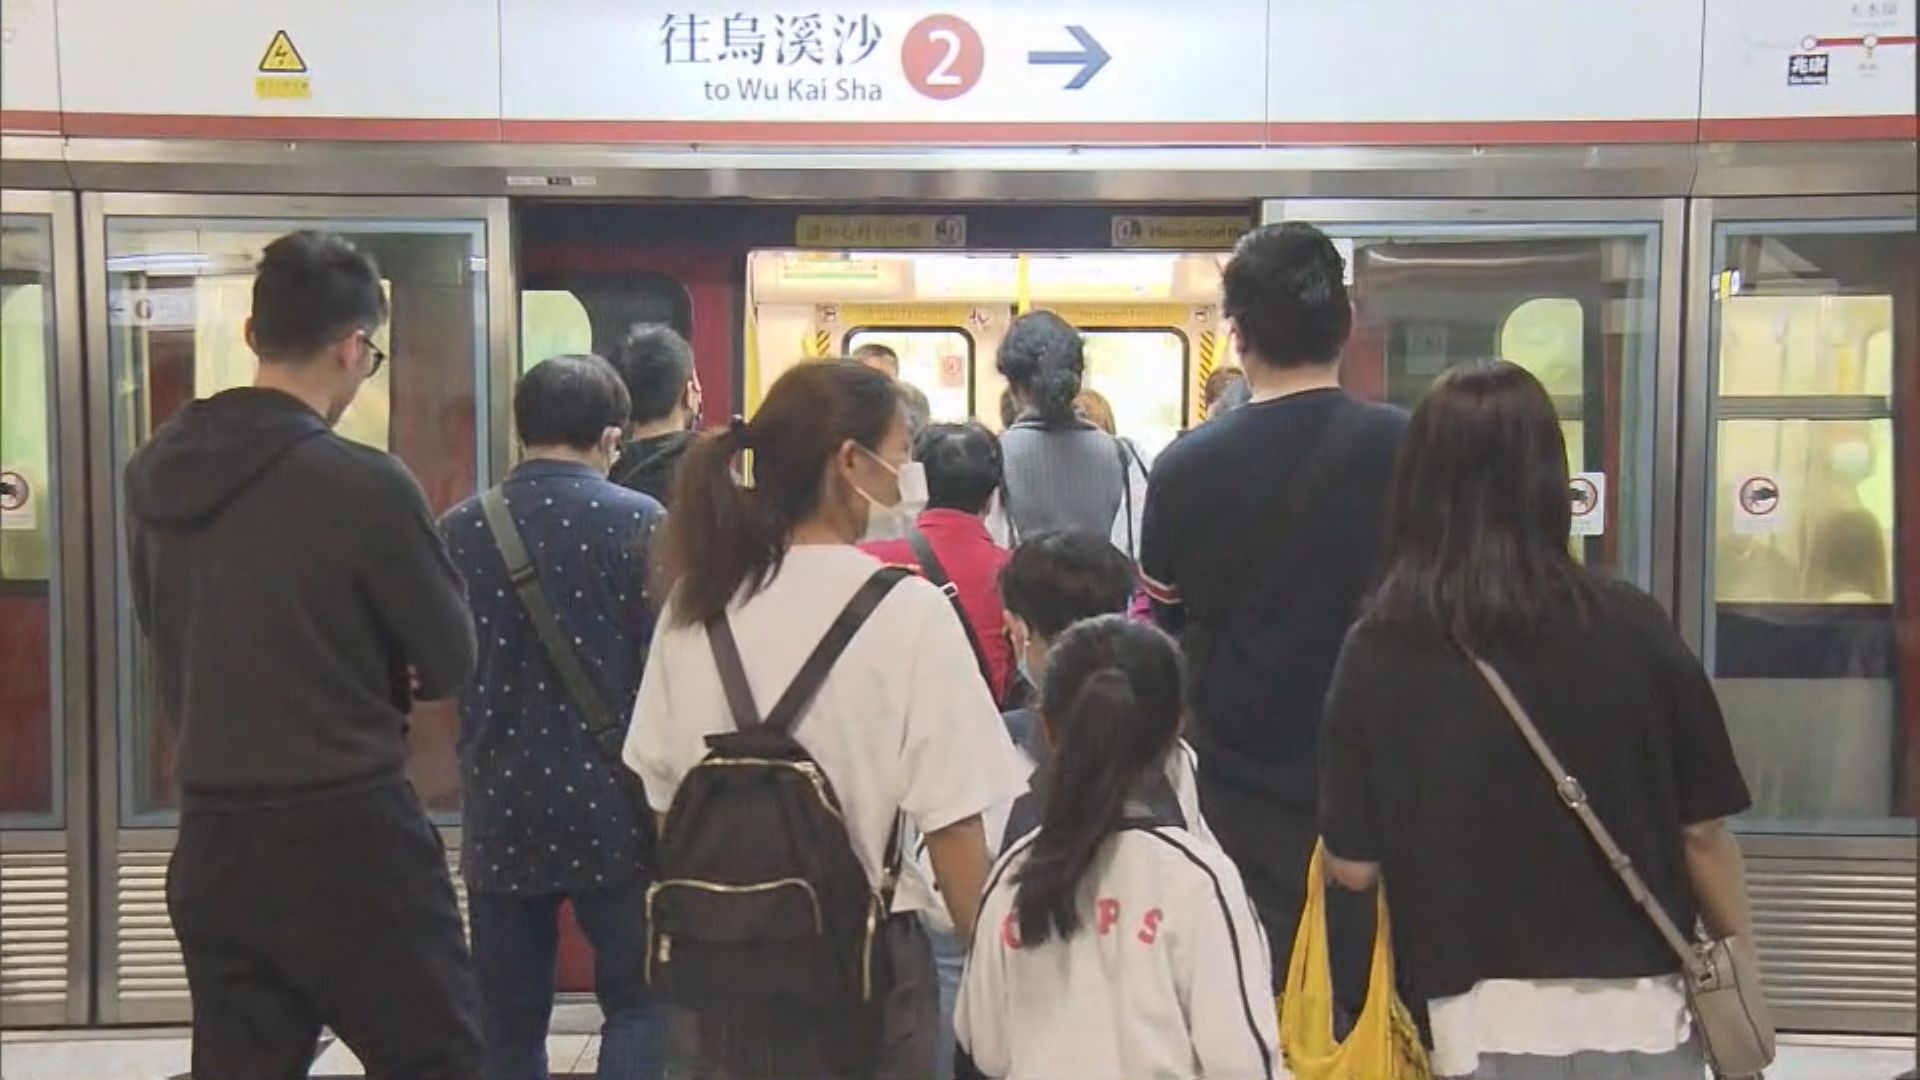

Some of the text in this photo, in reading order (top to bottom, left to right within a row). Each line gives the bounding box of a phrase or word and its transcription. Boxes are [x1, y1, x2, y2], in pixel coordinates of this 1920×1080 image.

[659, 12, 882, 66] 往烏溪沙
[926, 29, 962, 86] 2
[704, 77, 882, 101] to Wu Kai Sha
